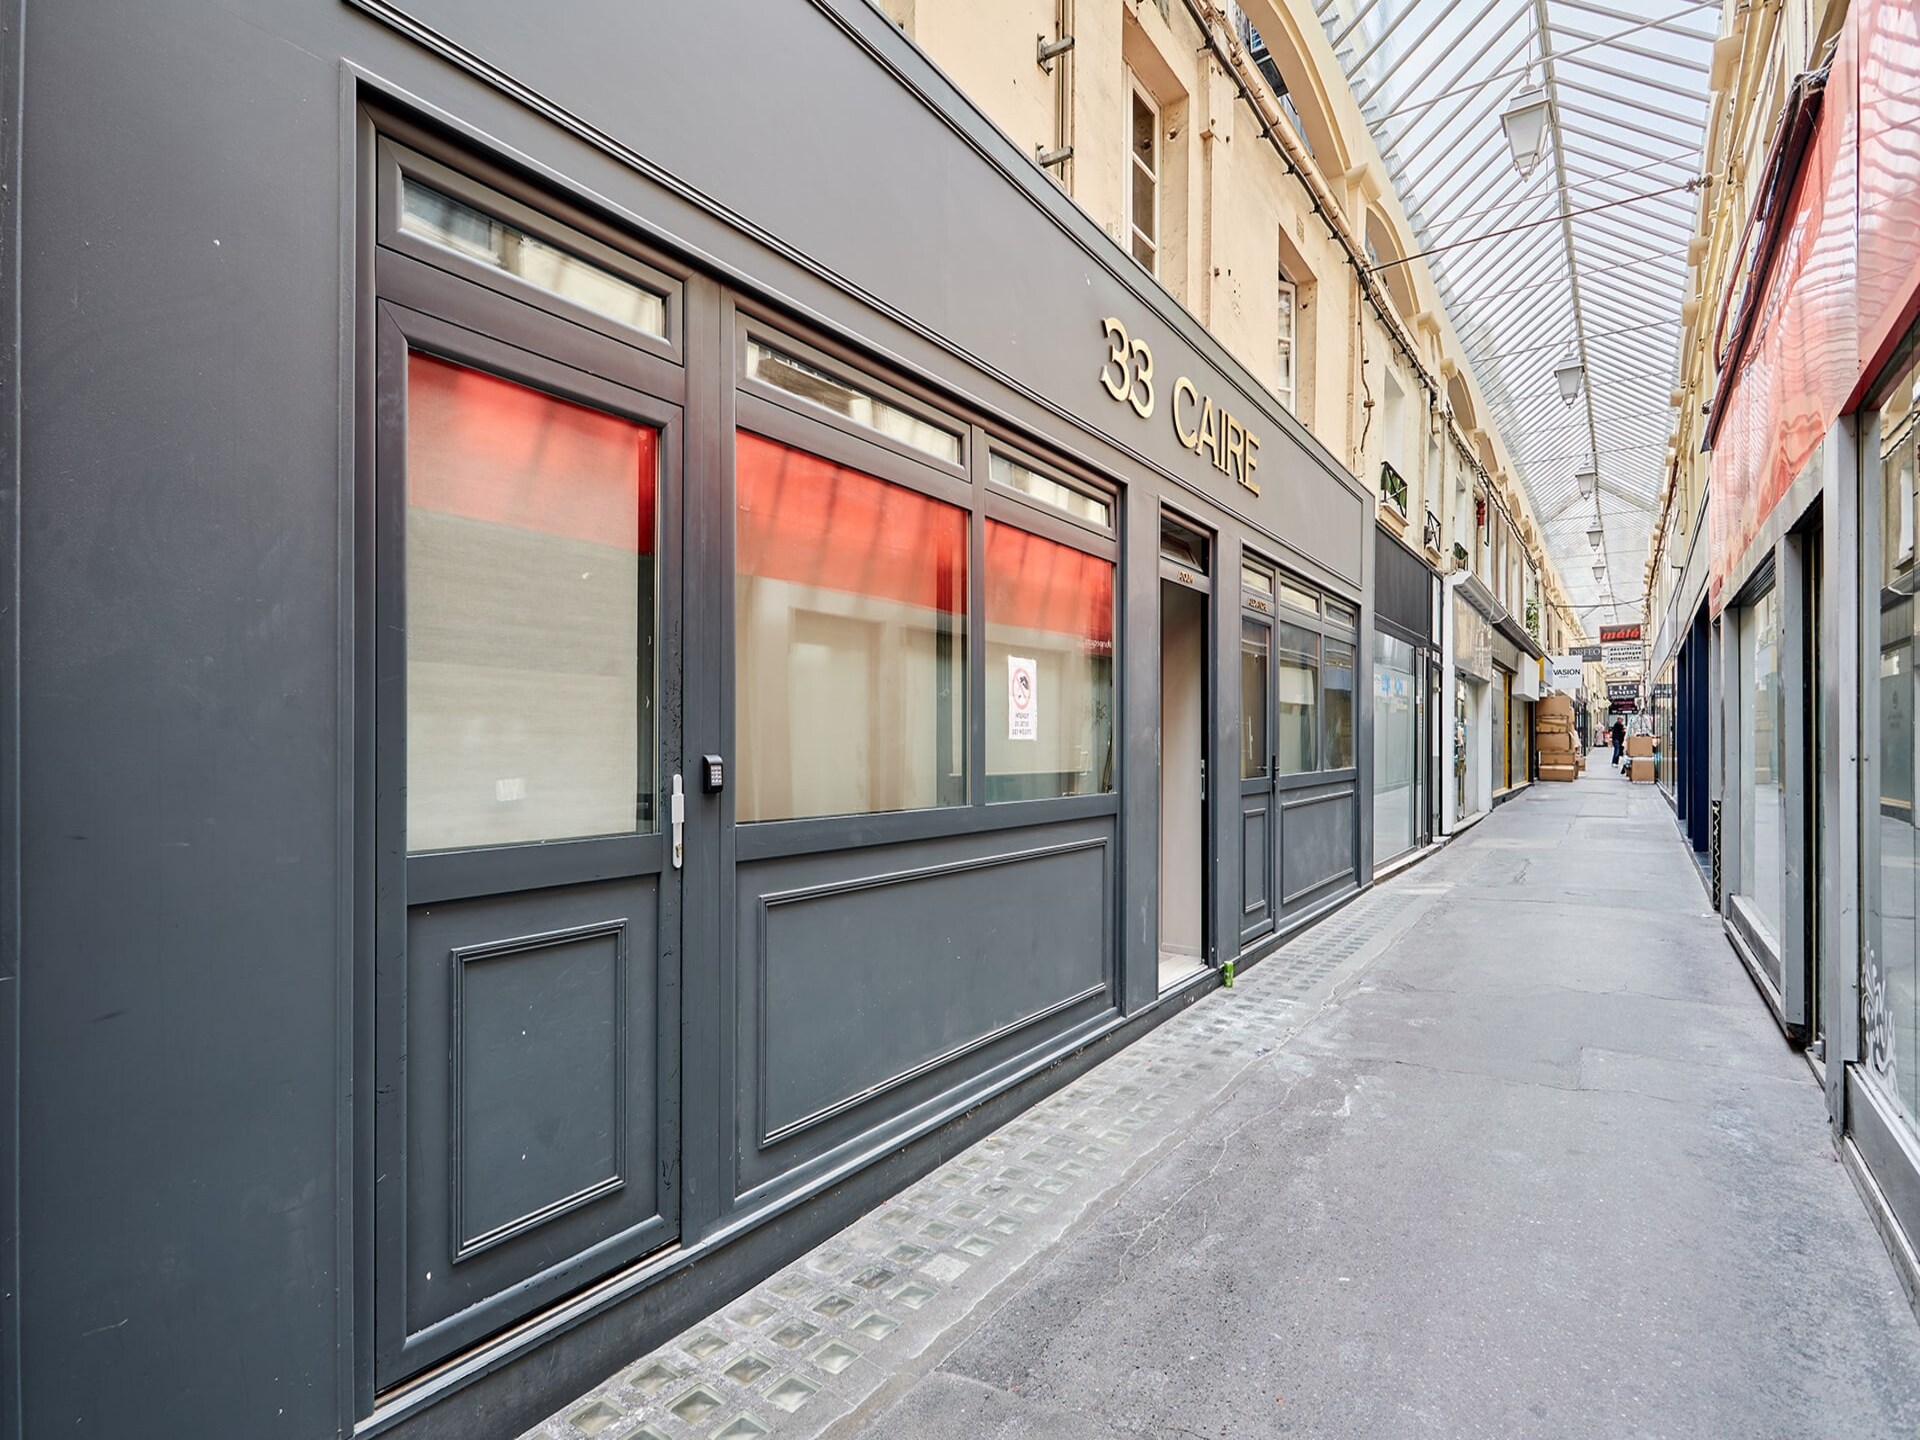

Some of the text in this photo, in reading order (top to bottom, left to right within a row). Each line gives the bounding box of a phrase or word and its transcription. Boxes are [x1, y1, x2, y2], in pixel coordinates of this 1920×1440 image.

[1100, 316, 1262, 497] 33 CAIRE
[1570, 648, 1601, 656] ORFEO
